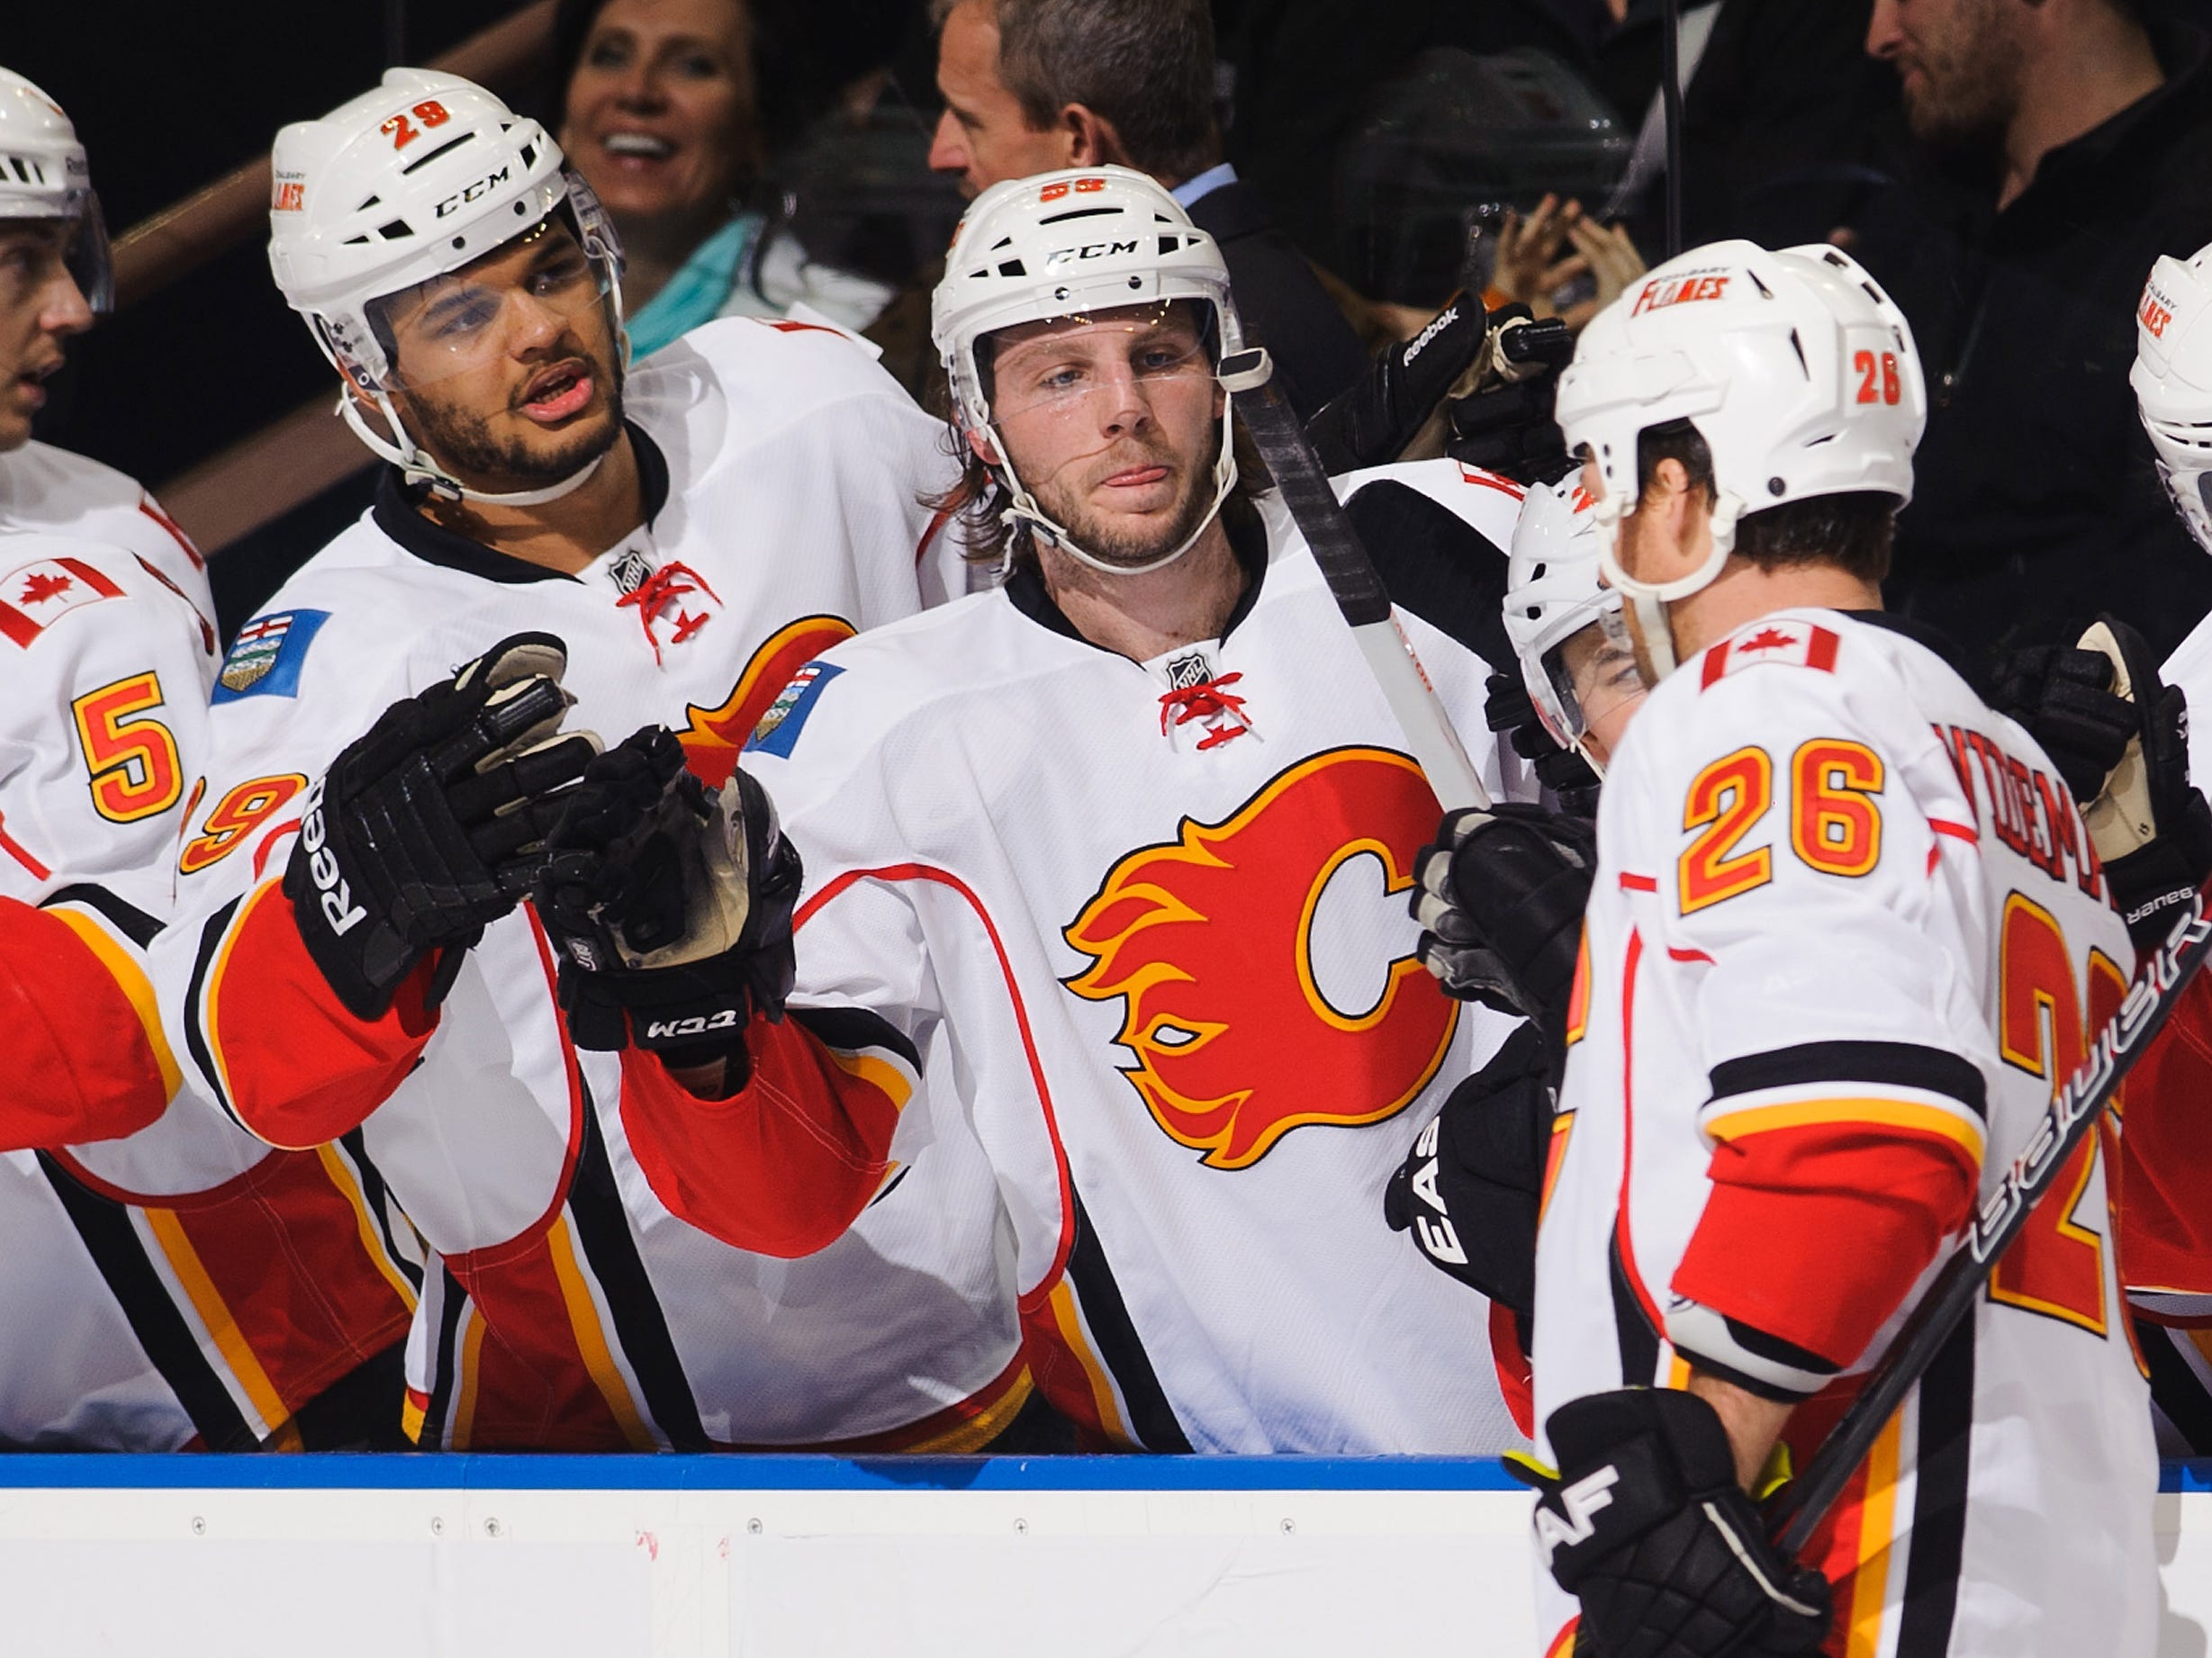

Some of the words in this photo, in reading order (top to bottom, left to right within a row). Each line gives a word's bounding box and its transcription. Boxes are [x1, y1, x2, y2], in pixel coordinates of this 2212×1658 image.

[380, 99, 450, 152] 29
[435, 166, 510, 219] CCM
[1046, 239, 1139, 267] CCM
[1630, 276, 1731, 318] FLAMES
[1853, 349, 1902, 406] 26
[71, 671, 182, 823] 5
[176, 771, 310, 877] 9
[1678, 737, 1885, 916] 26
[647, 1009, 737, 1039] CCM
